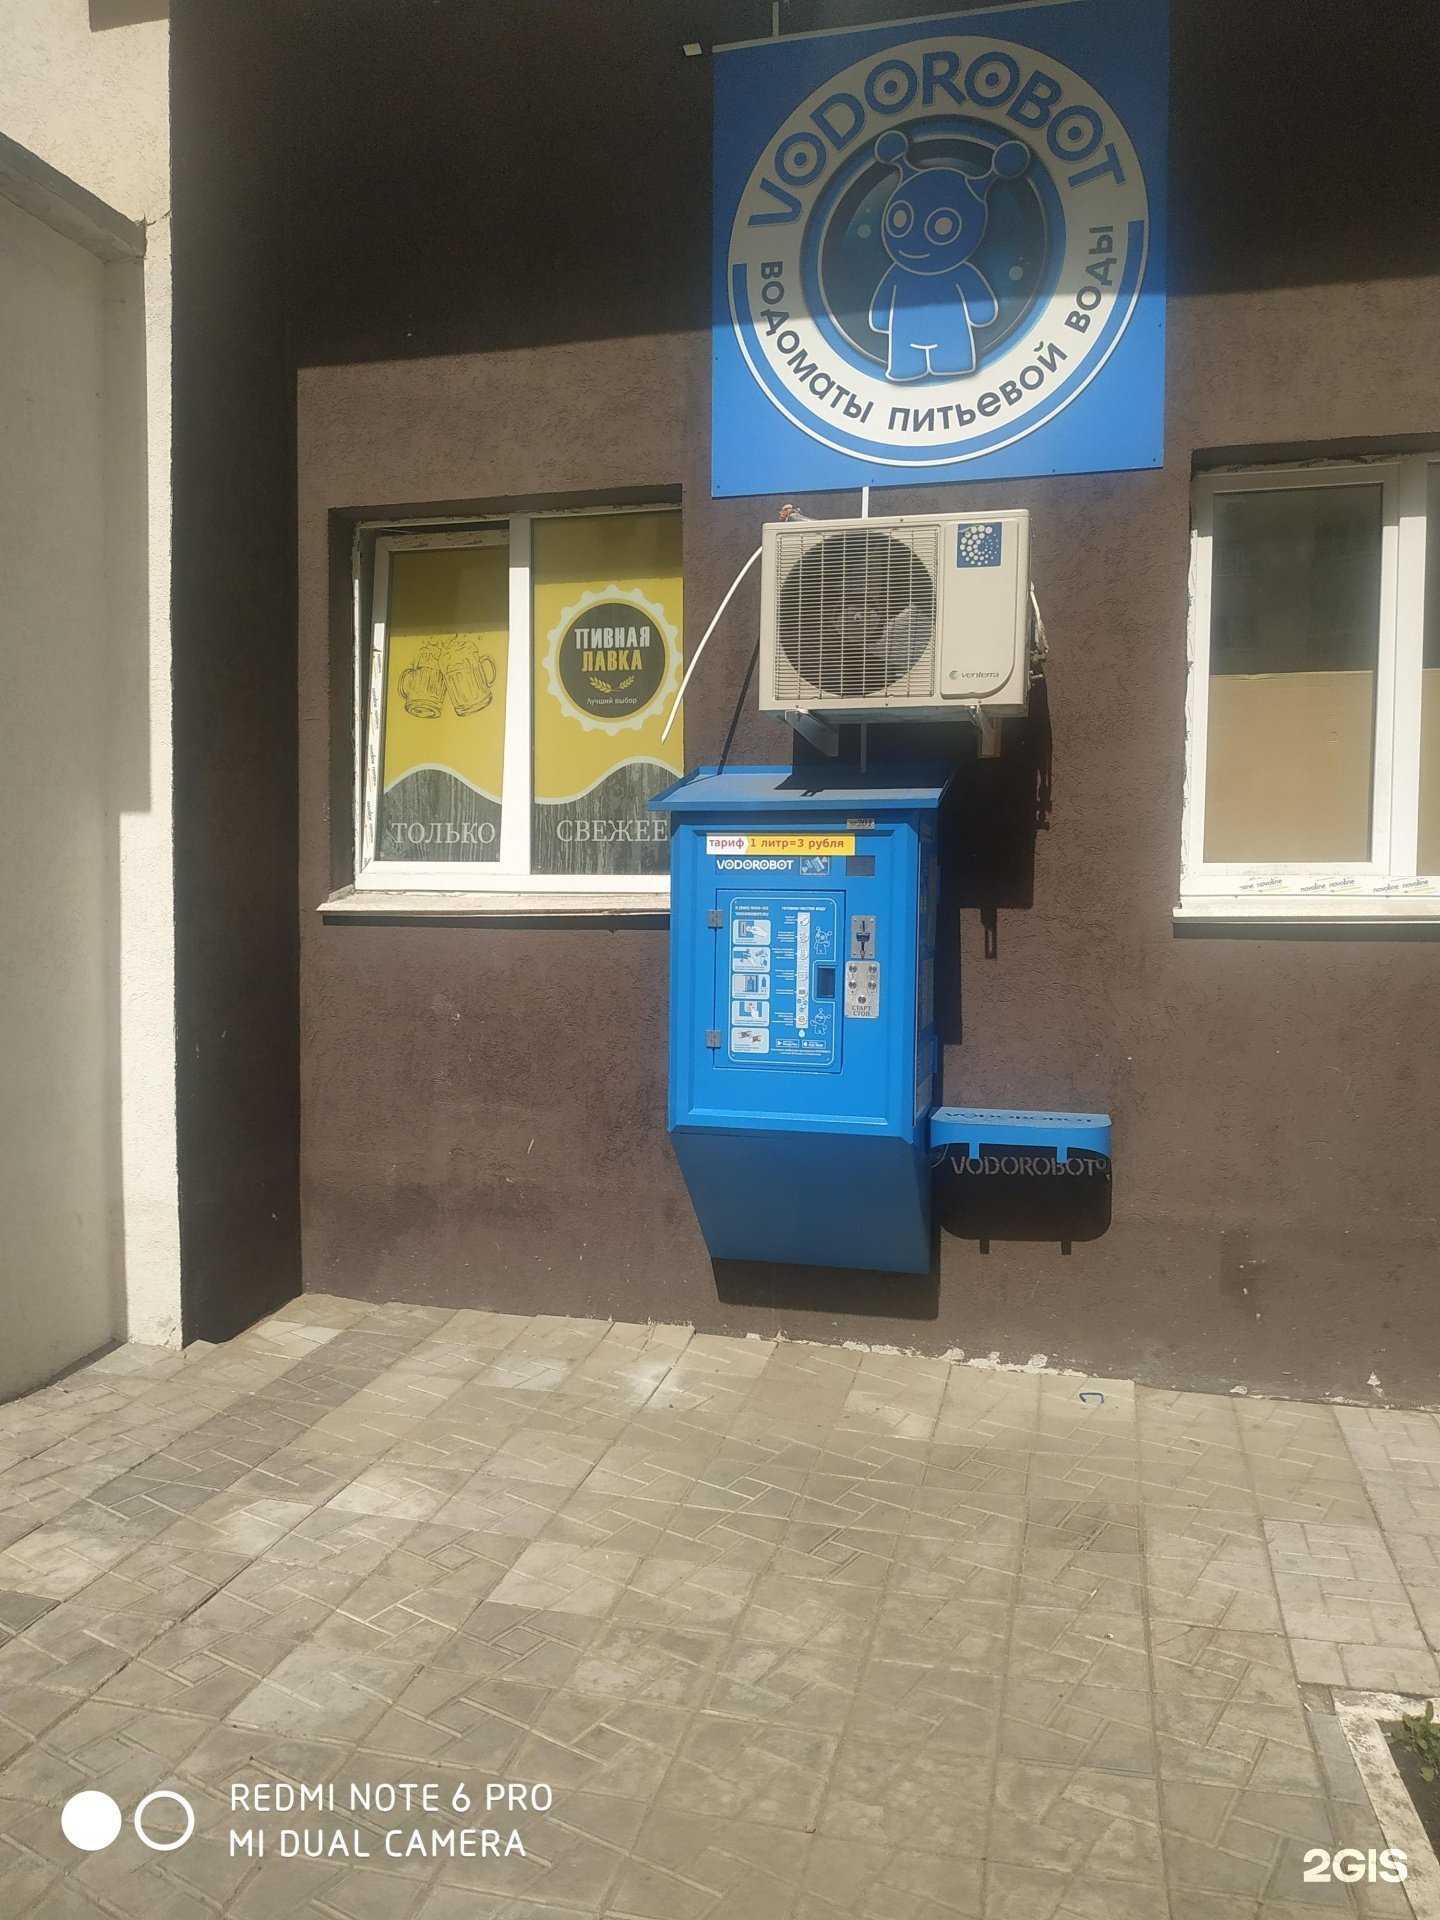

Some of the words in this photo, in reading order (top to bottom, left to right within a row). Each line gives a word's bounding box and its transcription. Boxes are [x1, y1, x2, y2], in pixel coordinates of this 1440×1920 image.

[747, 50, 1126, 228] VODOROBOT
[574, 625, 651, 650] ПИВНАЯ
[581, 649, 643, 672] ЛАВКА
[615, 695, 638, 705] выбор
[391, 822, 496, 844] ТОЛЬКО
[556, 819, 668, 842] СВЕЖЕЕ
[709, 838, 745, 849] тариф
[750, 838, 756, 848] 1
[808, 838, 844, 850] рубля
[716, 859, 795, 871] VODOROBOT
